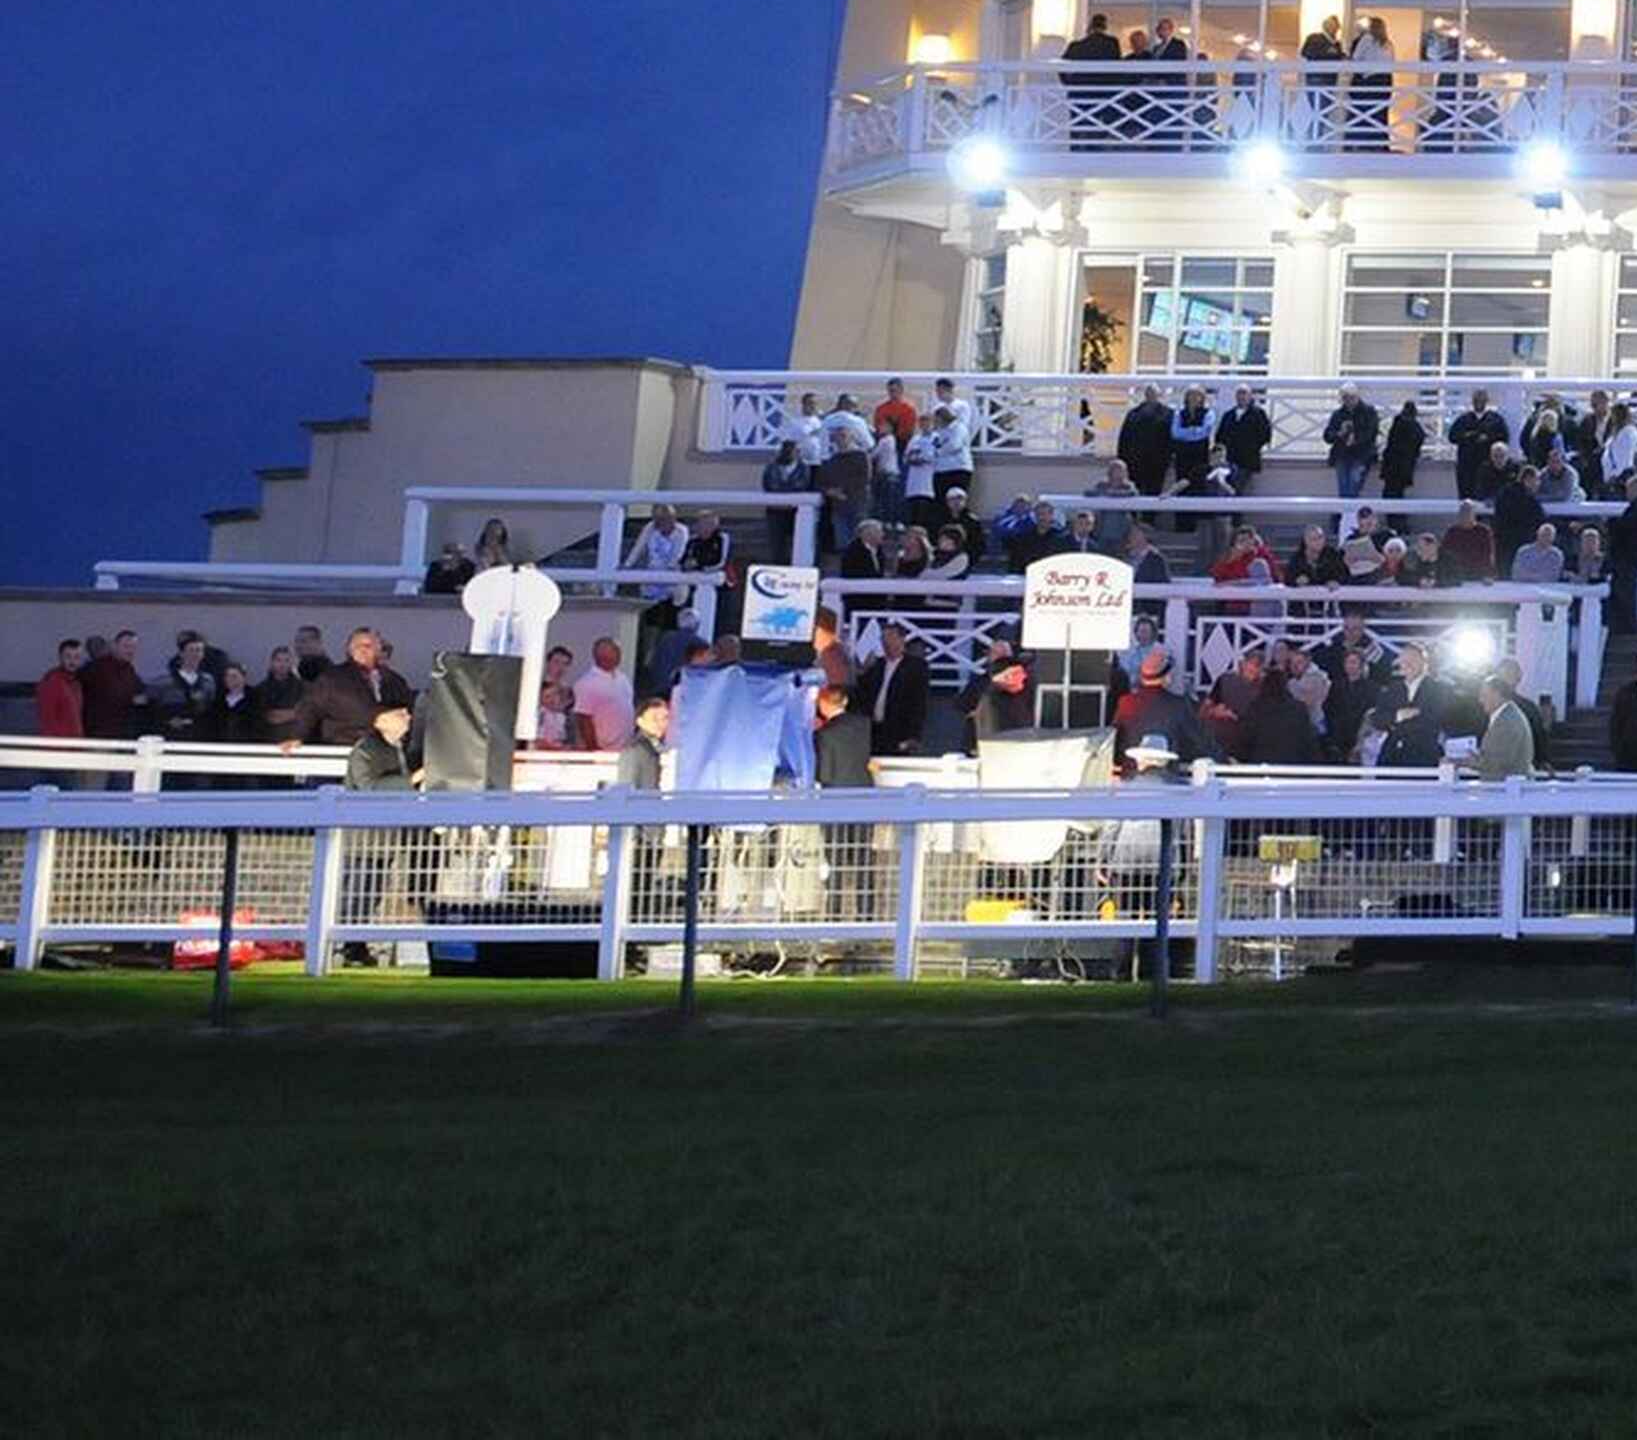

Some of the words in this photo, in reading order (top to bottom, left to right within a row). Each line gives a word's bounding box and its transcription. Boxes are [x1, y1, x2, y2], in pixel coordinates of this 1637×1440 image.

[1045, 570, 1090, 592] Barry
[1029, 589, 1091, 609] Johnson
[1095, 589, 1128, 608] Ltd
